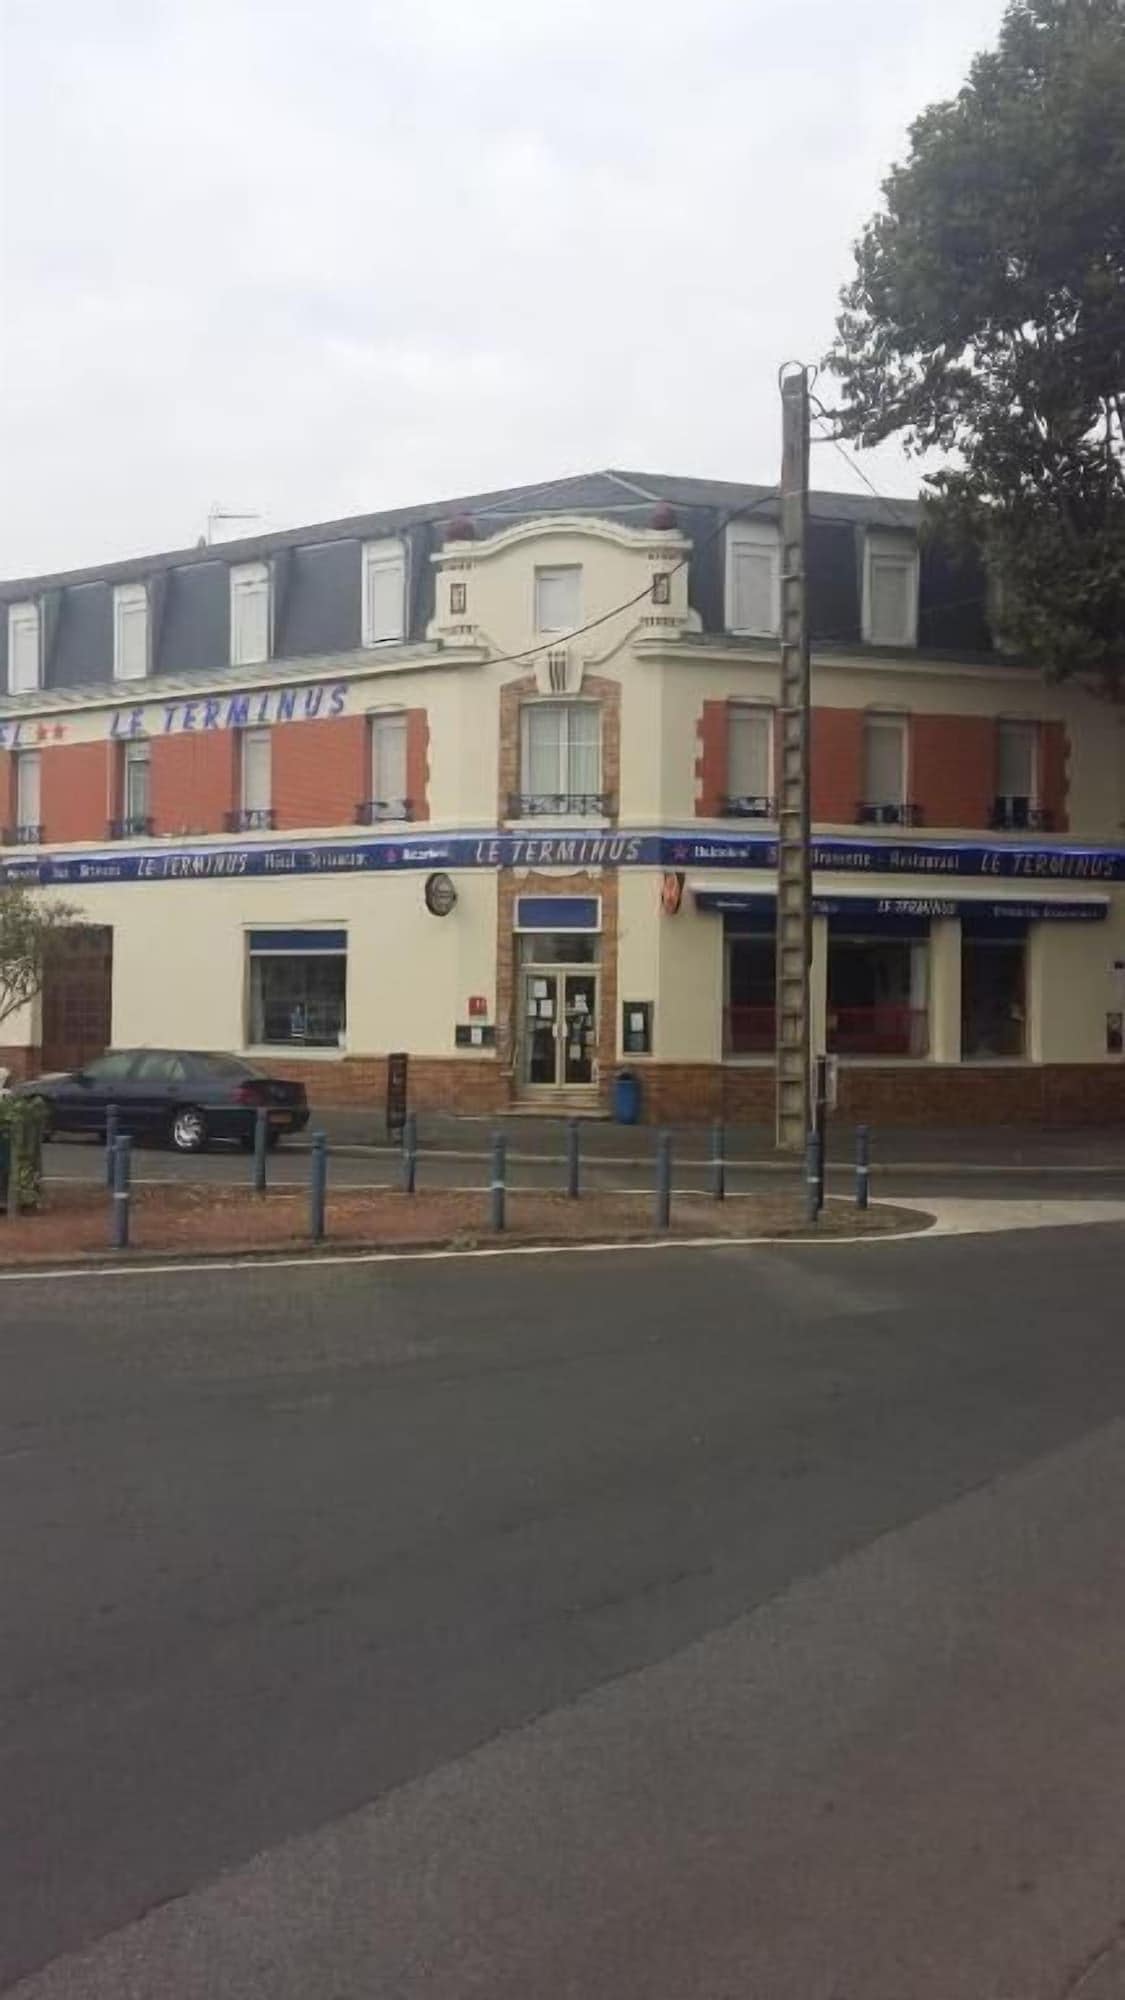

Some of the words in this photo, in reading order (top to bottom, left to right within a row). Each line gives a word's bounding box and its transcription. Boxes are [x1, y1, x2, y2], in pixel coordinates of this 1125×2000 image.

[110, 708, 144, 737] LE
[164, 685, 348, 732] TERMINUS
[472, 840, 499, 864] LE
[511, 838, 641, 864] TERMINUS
[137, 856, 155, 876] LE
[162, 853, 248, 876] TERMINUS
[981, 853, 1000, 873] LE
[1012, 853, 1116, 876] TERMINUS
